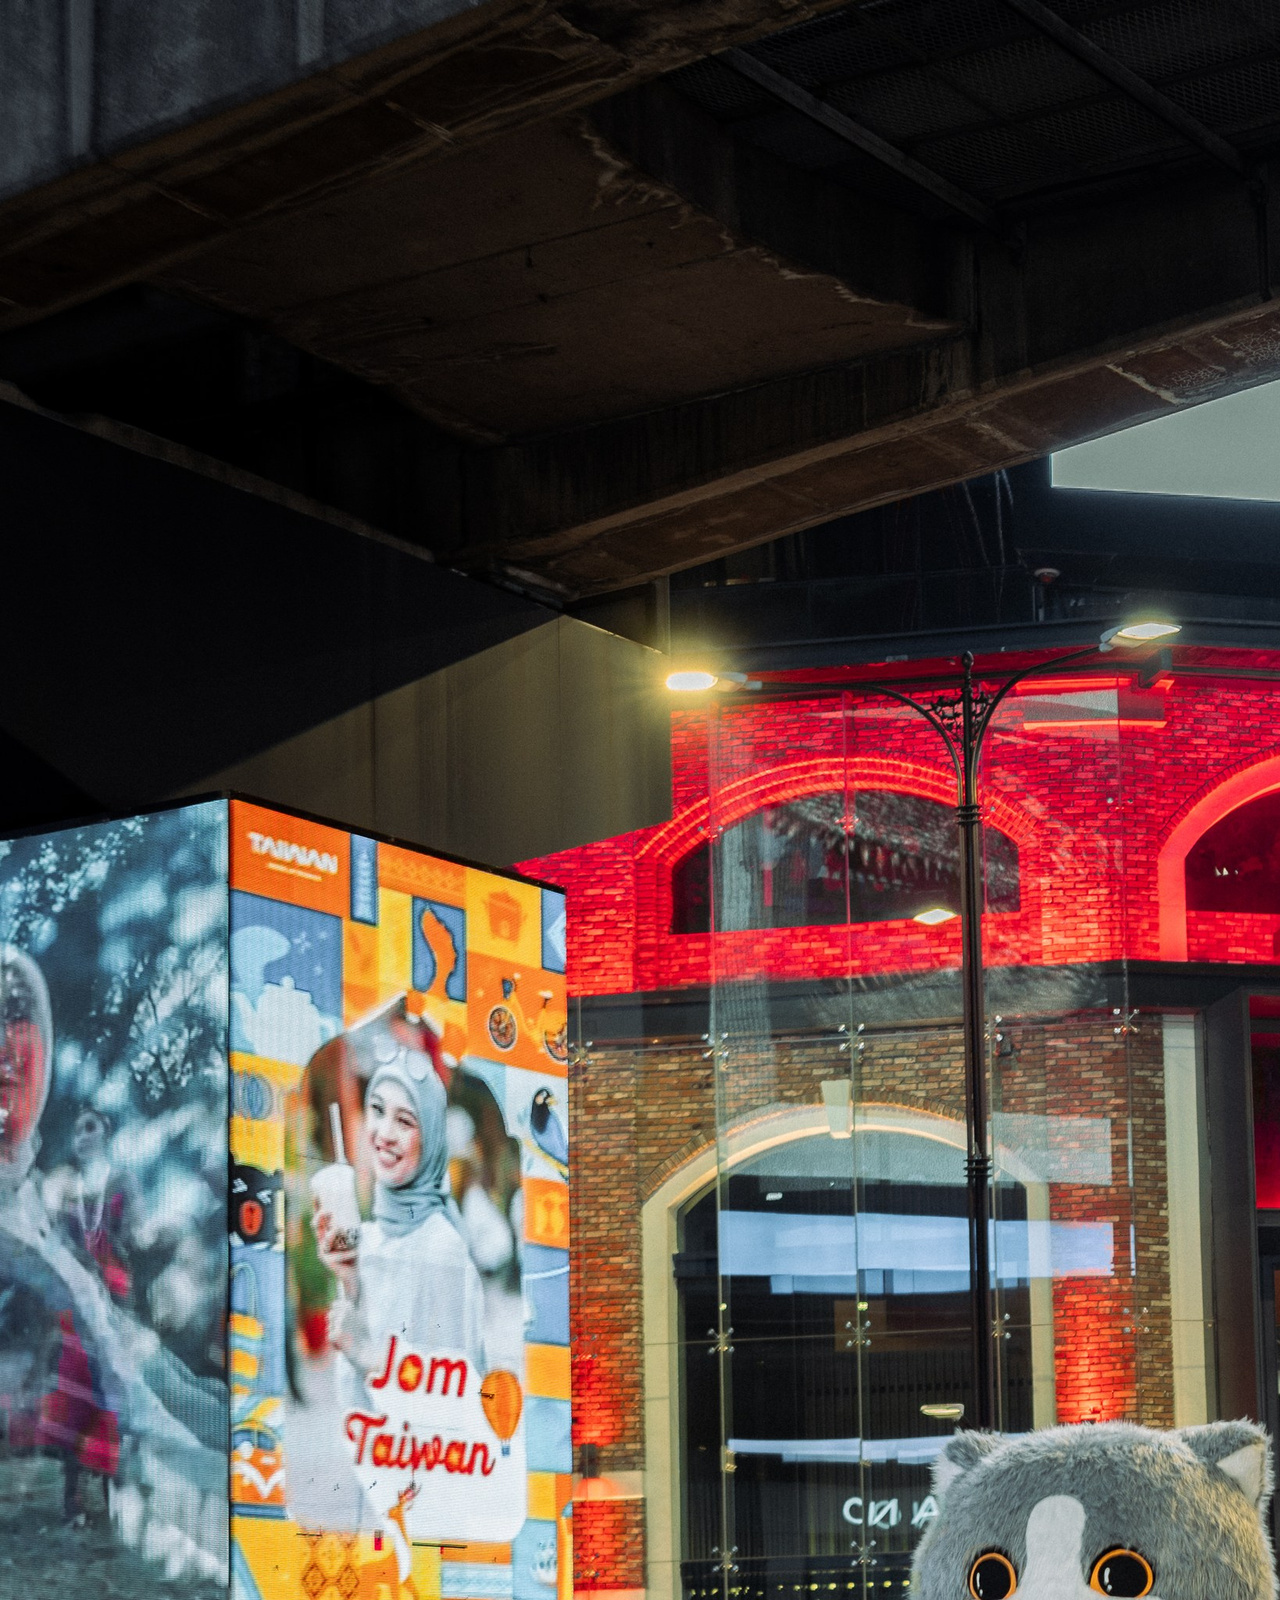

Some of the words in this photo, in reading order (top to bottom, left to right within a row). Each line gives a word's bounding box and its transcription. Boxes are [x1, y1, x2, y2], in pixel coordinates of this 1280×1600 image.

[247, 831, 338, 875] TAIWAN
[371, 1335, 469, 1398] Jom
[345, 1411, 496, 1477] Taiwan
